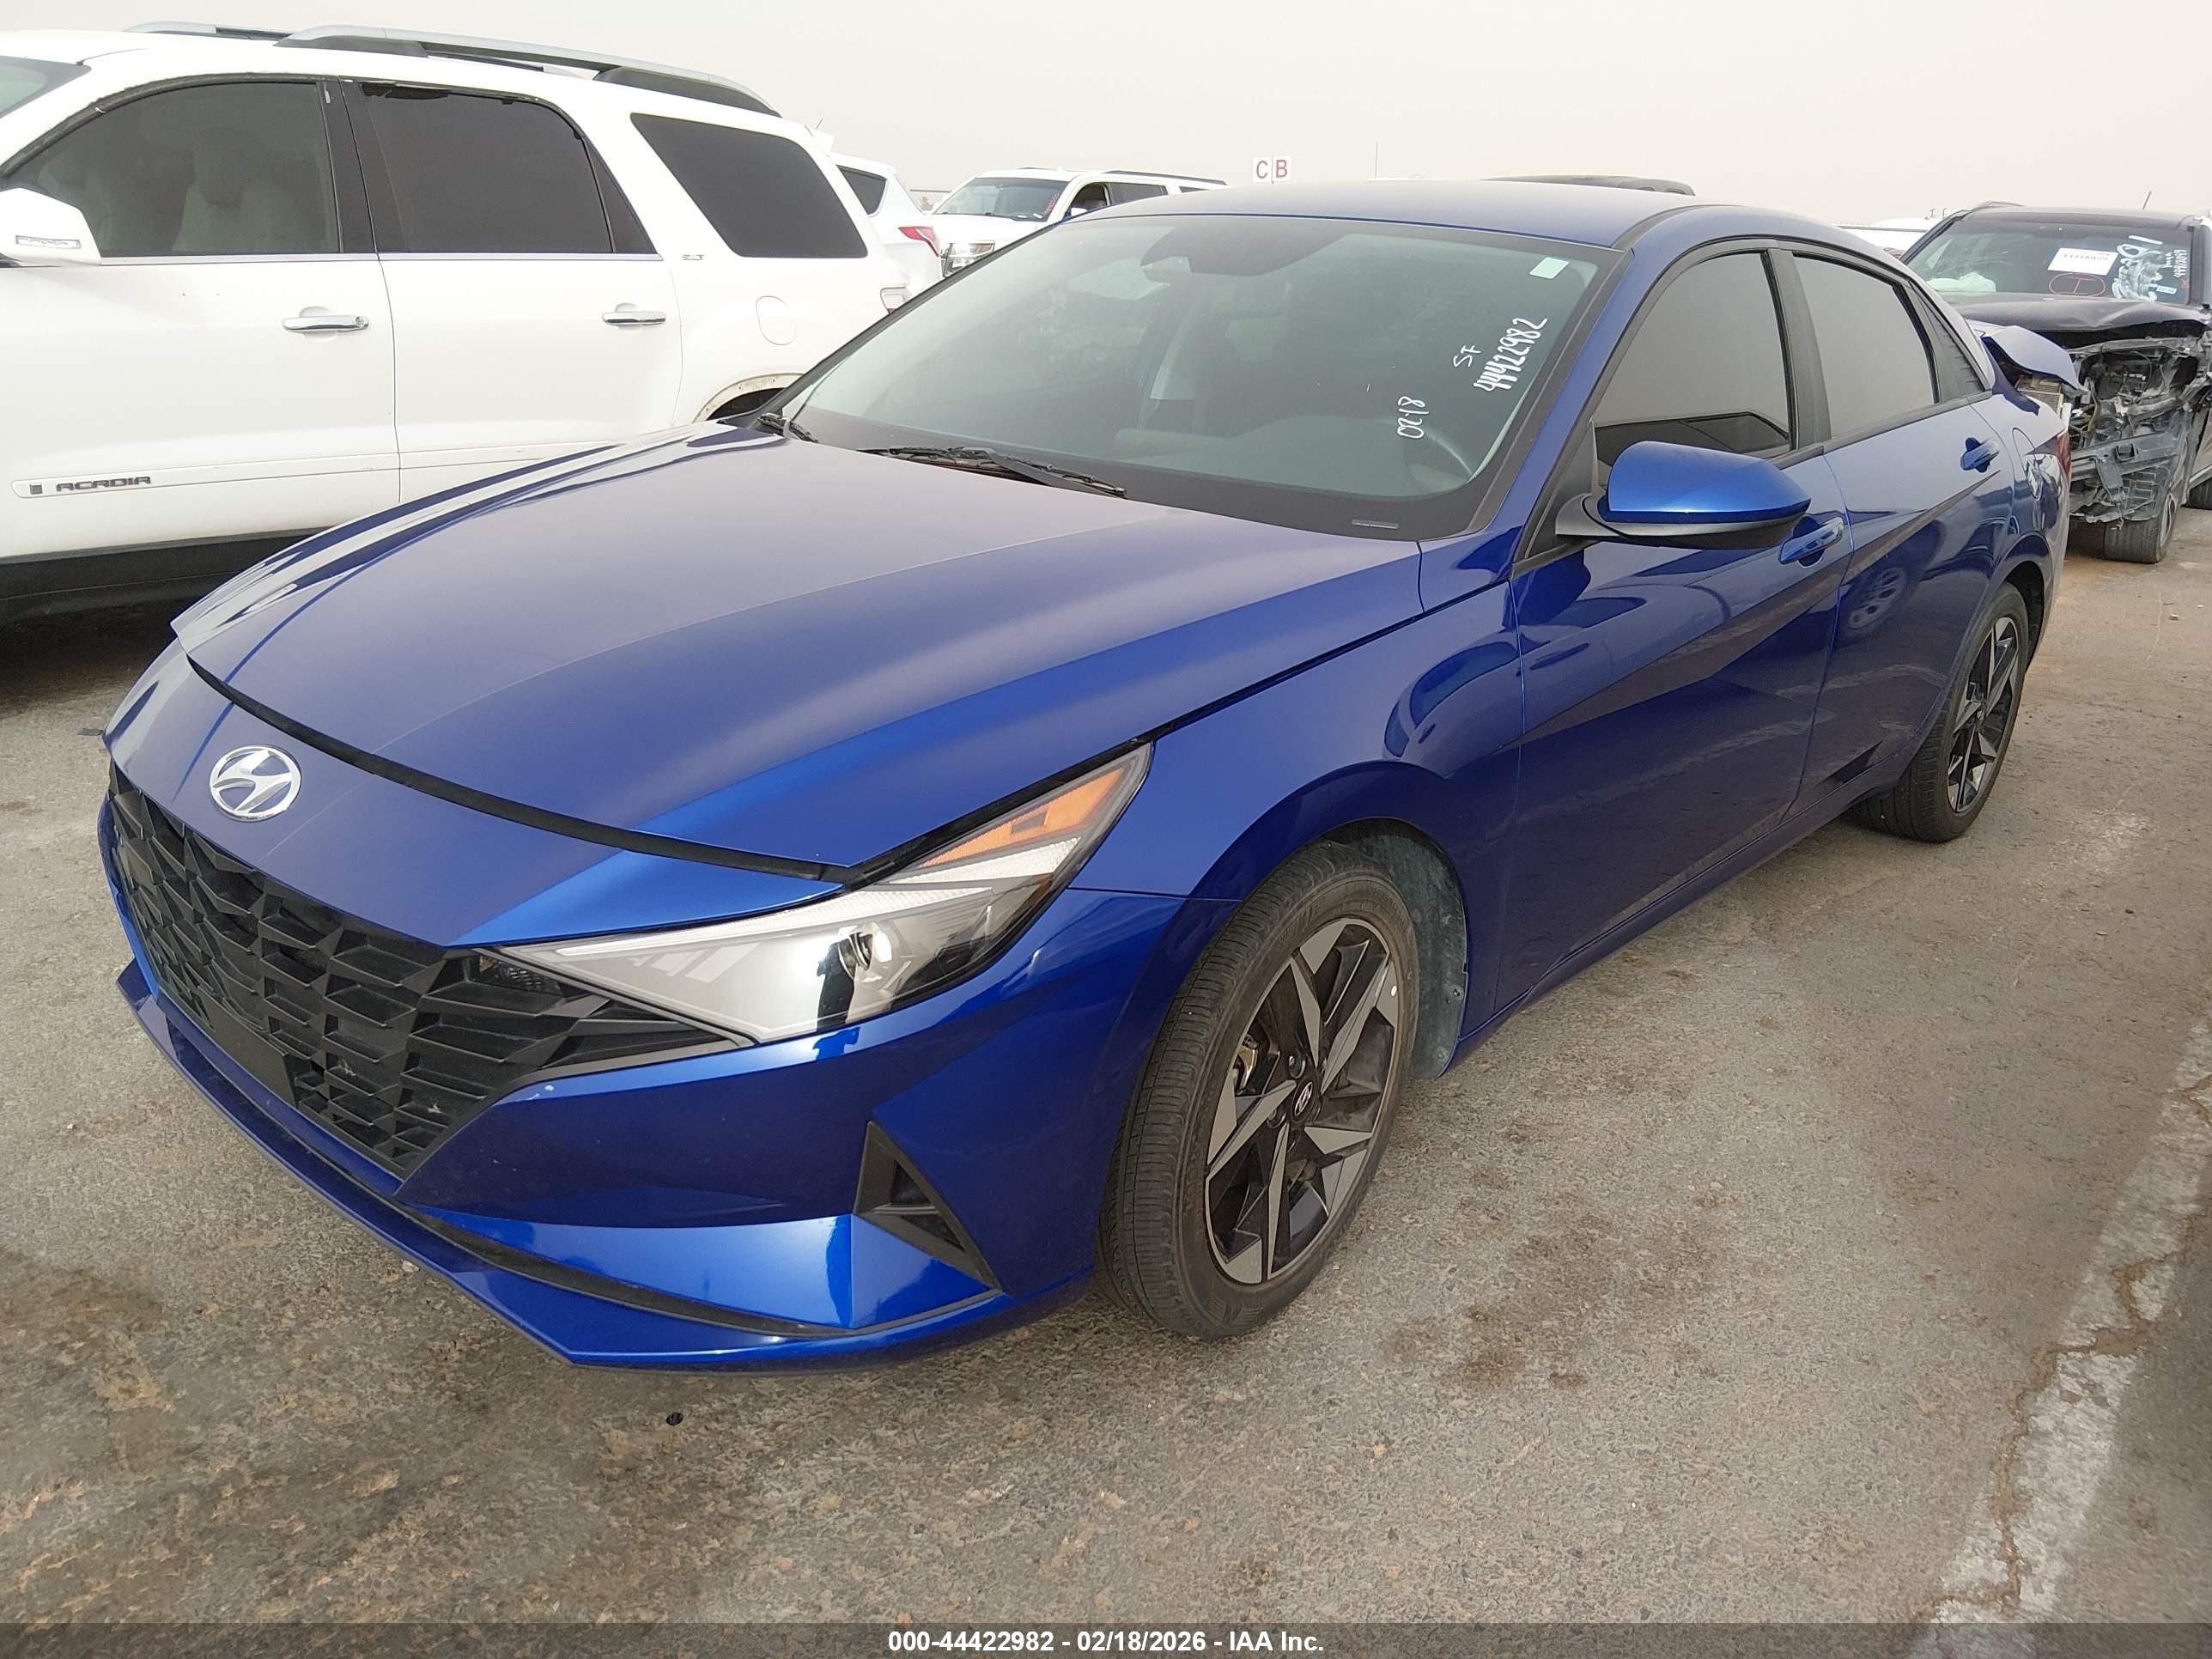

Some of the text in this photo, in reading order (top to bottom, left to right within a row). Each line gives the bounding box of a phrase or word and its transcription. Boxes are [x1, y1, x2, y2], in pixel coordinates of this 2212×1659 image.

[1256, 159, 1288, 179] C B
[1453, 344, 1481, 368] SF
[1473, 317, 1547, 392] 44422982
[56, 476, 151, 492] ACADIA
